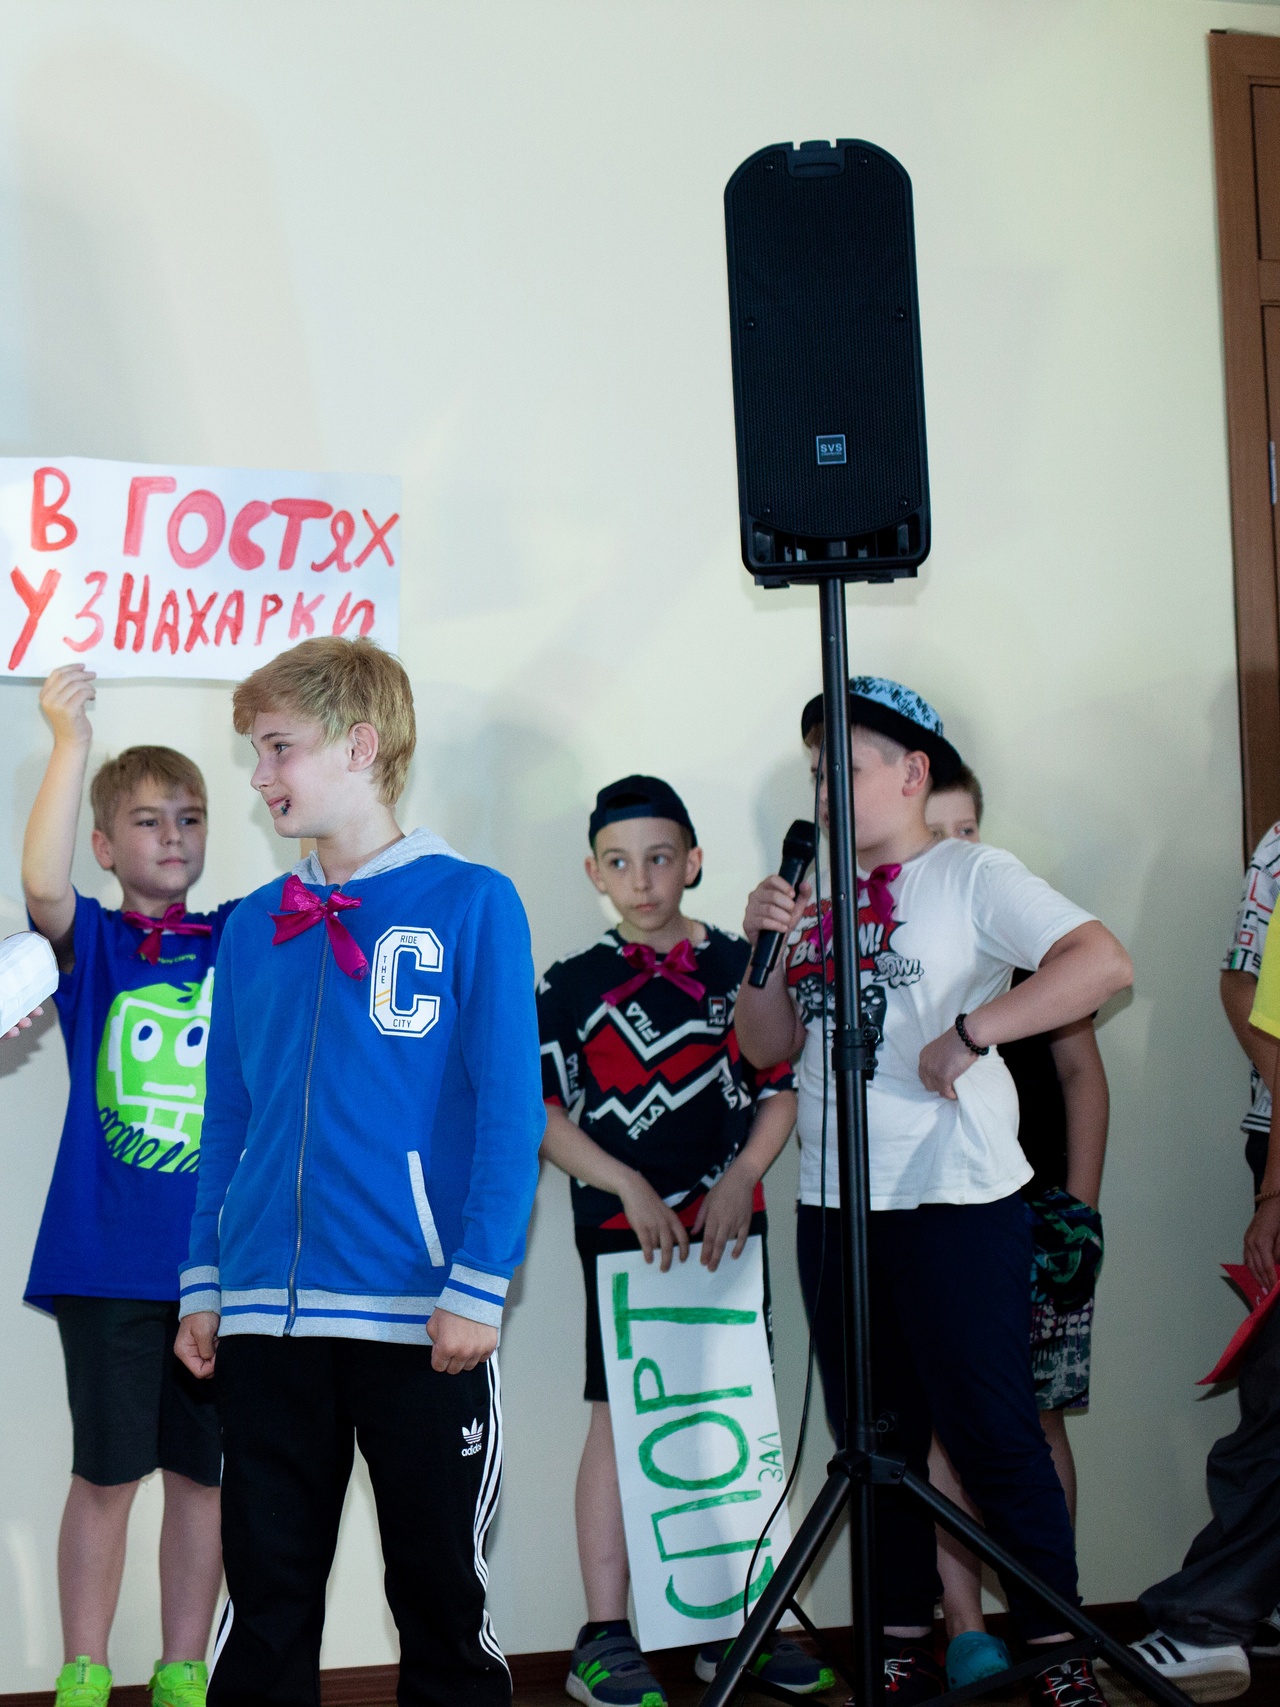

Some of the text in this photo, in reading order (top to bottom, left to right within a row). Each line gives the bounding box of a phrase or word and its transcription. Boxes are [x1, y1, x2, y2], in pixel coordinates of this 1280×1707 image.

[820, 443, 843, 453] SVS
[30, 466, 400, 573] В ГОСТЯХ
[8, 565, 375, 671] У ЗНАХАРКИ
[400, 935, 418, 945] RIDE
[369, 925, 444, 1038] C
[876, 957, 920, 978] POW!
[392, 1019, 412, 1028] CITY
[625, 1001, 661, 1042] FILA
[566, 1053, 579, 1090] FILA
[627, 1104, 665, 1140] FILA
[461, 1443, 482, 1457] adidas
[611, 1272, 776, 1620] СПОРТ
[757, 1432, 784, 1484] ЗАЛ
